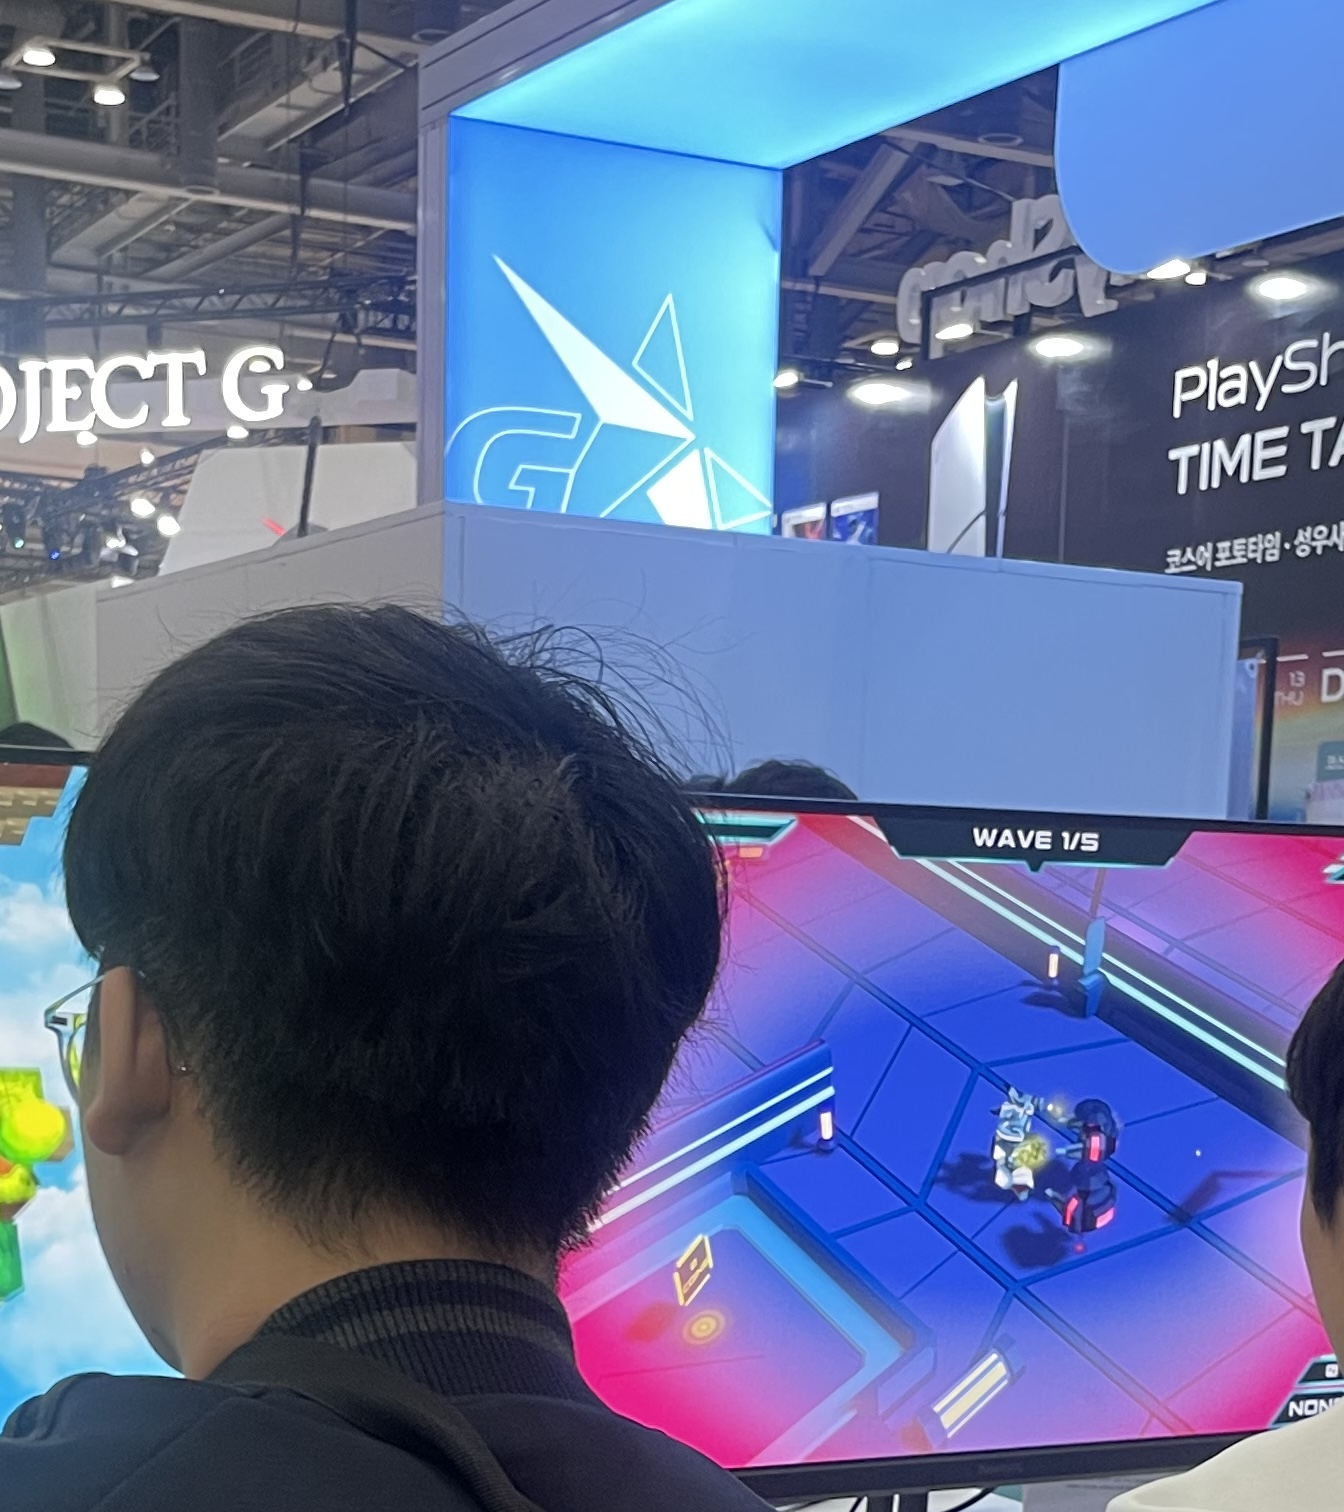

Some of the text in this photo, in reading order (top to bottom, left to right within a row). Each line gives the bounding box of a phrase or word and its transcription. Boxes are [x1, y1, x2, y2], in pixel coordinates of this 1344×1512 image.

[221, 344, 291, 424] G
[1168, 424, 1288, 496] TIME
[1164, 541, 1212, 574] 코스어
[1213, 531, 1282, 568] 포토타임
[972, 827, 1100, 853] WAVE 1/5
